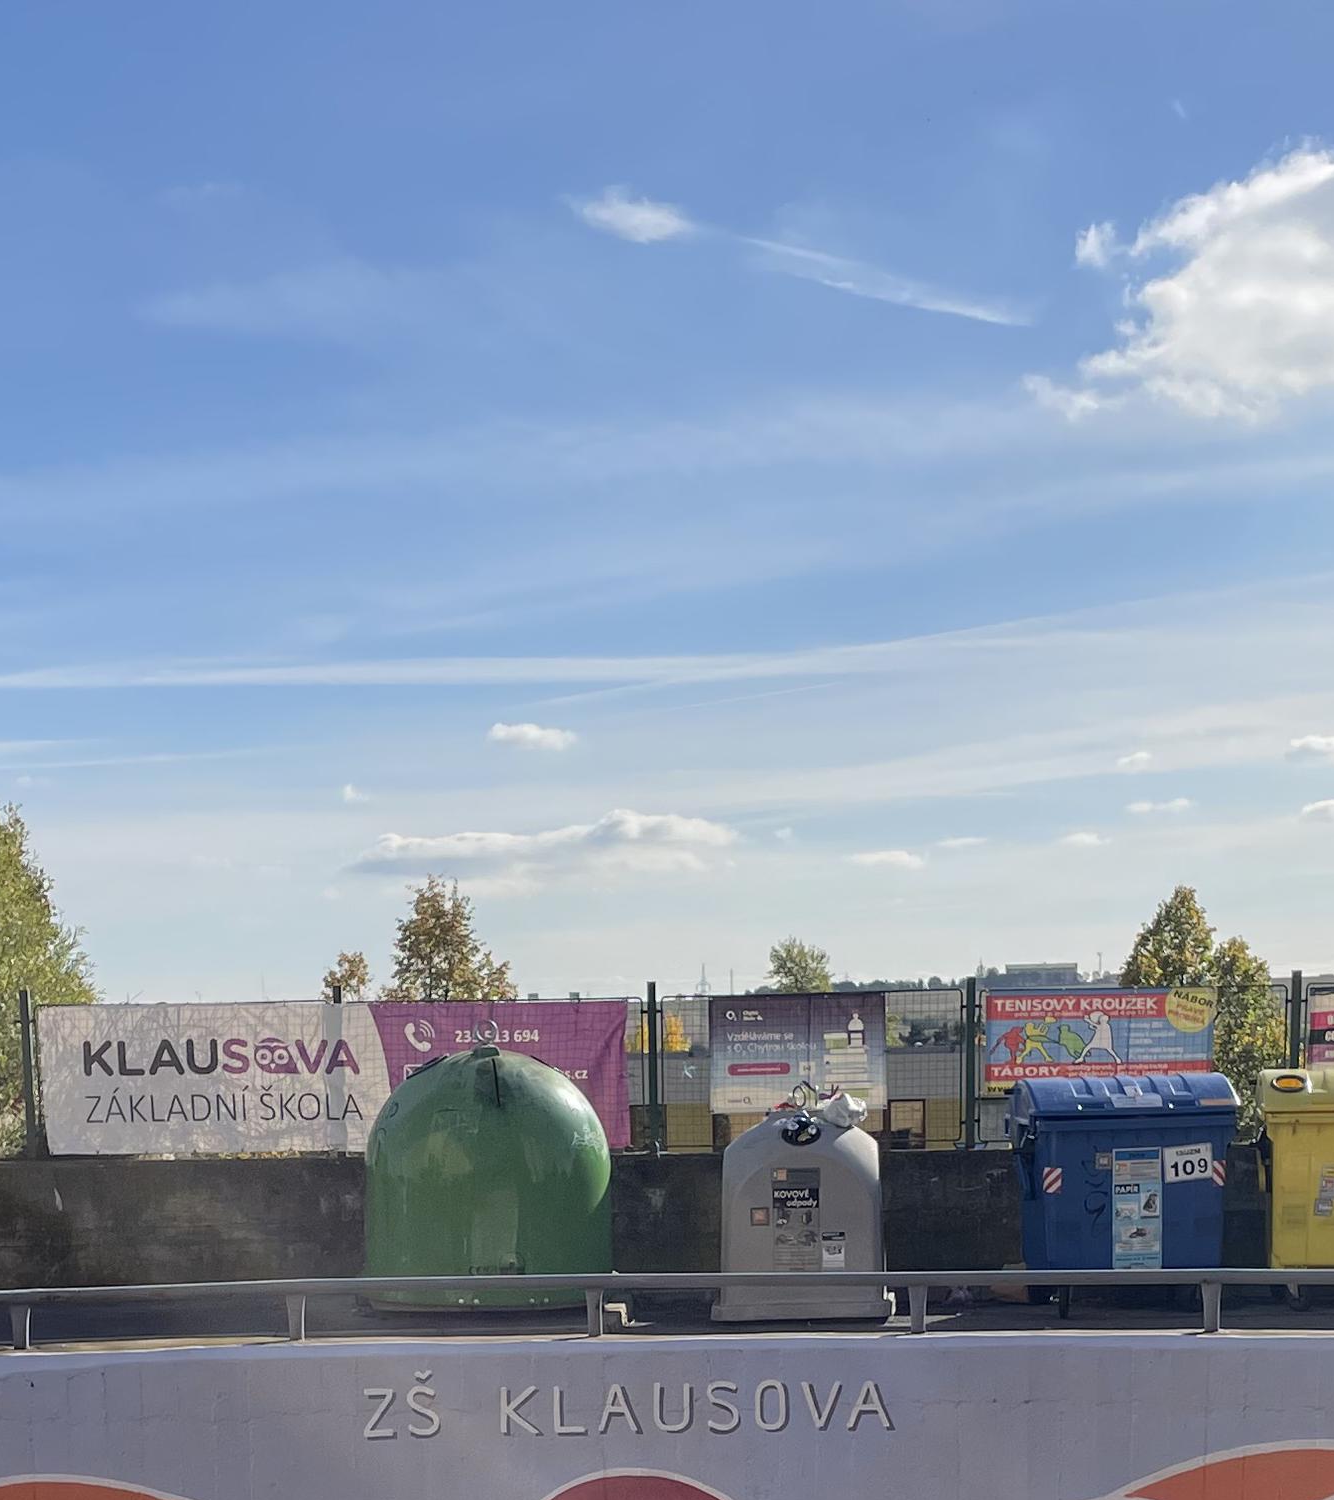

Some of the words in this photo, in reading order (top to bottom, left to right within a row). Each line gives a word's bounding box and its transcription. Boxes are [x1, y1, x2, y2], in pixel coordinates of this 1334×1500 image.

[995, 996, 1077, 1012] TENISOVÝ
[513, 1029, 540, 1043] 694
[84, 1087, 250, 1124] ZÁKLADNÍ
[258, 1084, 364, 1122] ŠKOLA
[1170, 1158, 1209, 1177] 109
[363, 1369, 443, 1439] ZŠ
[499, 1380, 896, 1437] KLAUSOVA
